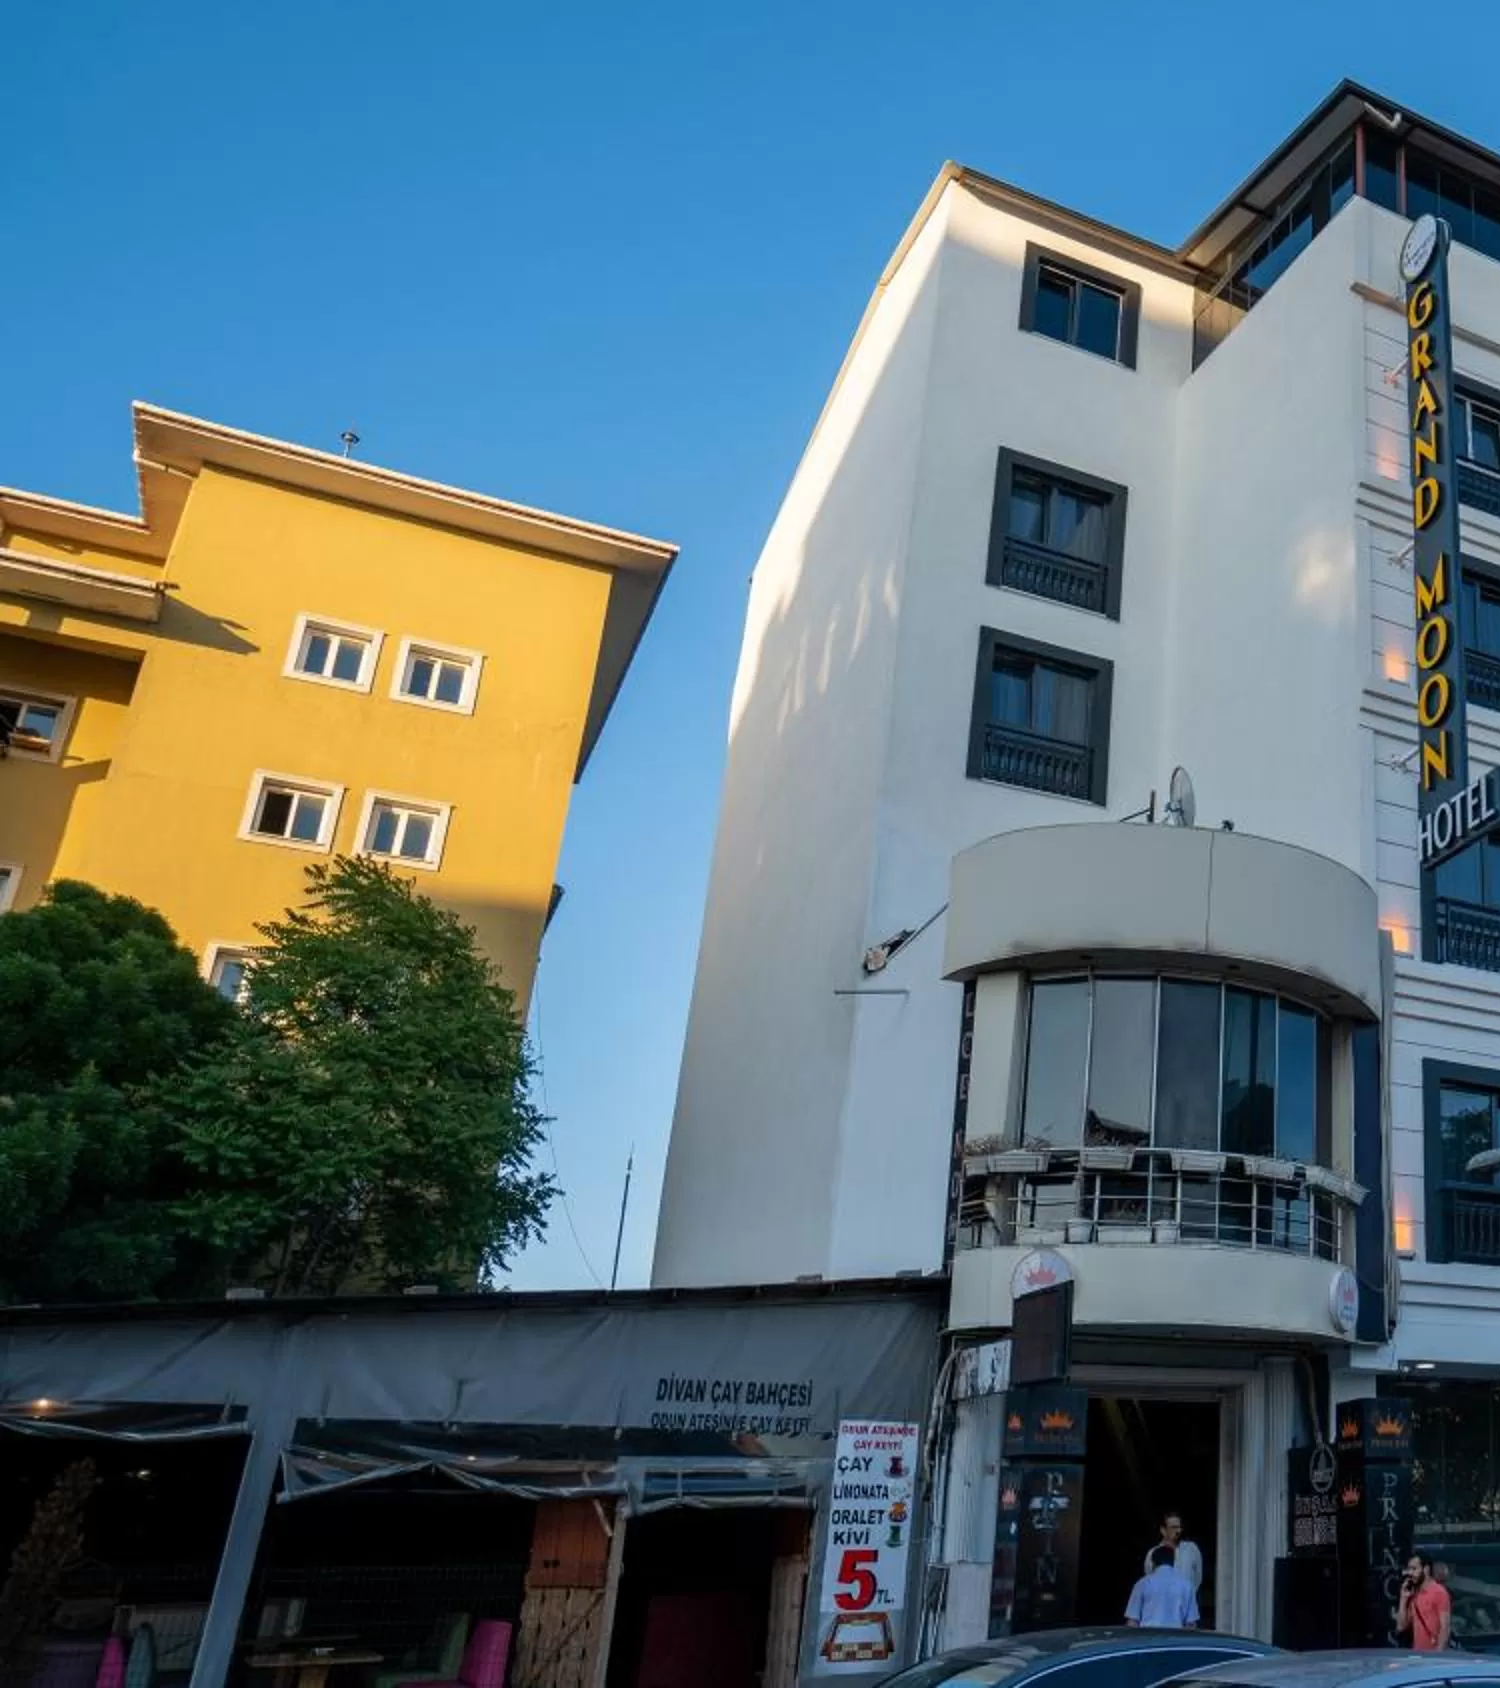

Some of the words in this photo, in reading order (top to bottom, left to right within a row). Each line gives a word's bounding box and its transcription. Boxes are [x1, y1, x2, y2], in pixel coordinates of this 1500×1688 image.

[1408, 281, 1440, 529] GRAND
[1416, 552, 1449, 791] MOON
[1418, 773, 1496, 861] HOTEL
[656, 1372, 707, 1403] DİVAN
[711, 1380, 743, 1410] ÇAY
[745, 1379, 813, 1411] BAHÇESİ
[837, 1456, 873, 1477] ÇAY
[833, 1480, 889, 1500] LİMONATA
[831, 1509, 885, 1525] ORALET
[833, 1527, 871, 1545] KİVİ
[834, 1549, 879, 1610] 5
